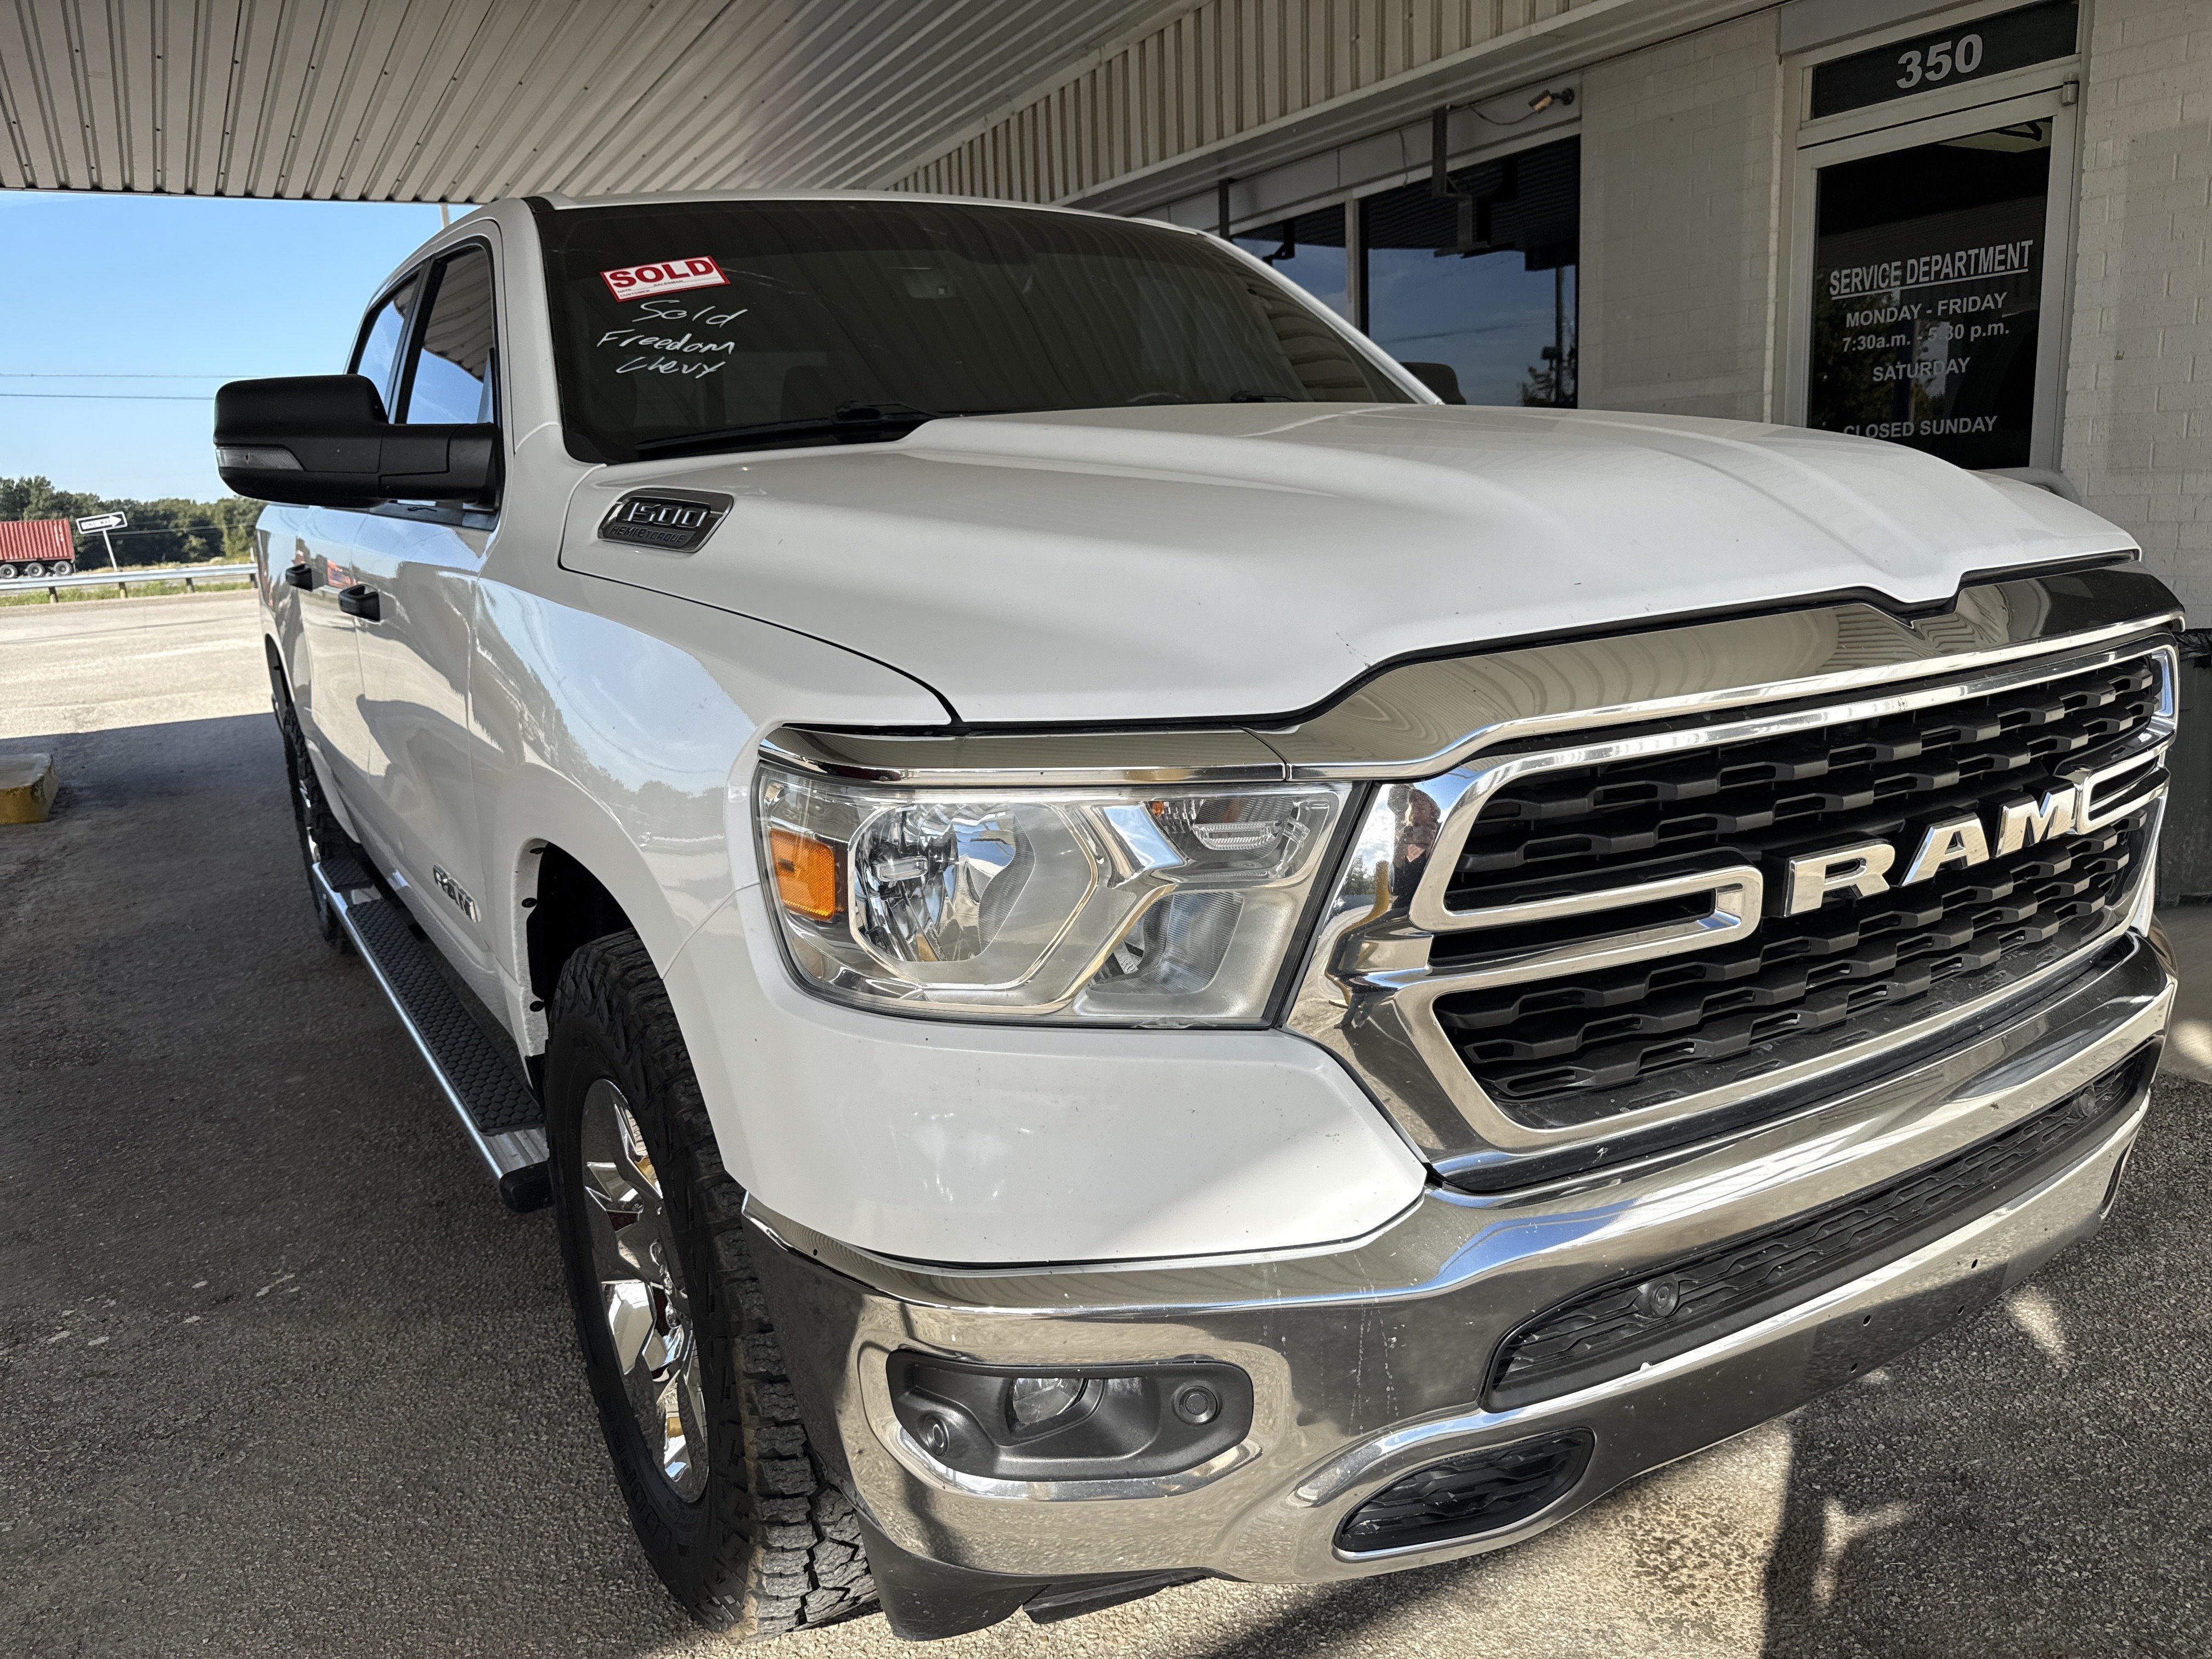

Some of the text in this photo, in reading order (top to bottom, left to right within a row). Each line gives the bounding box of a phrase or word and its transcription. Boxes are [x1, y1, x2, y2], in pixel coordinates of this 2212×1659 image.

[1896, 33, 1983, 89] 350
[609, 259, 714, 287] SOLD
[1830, 240, 2033, 296] SERVICE DEPARTMENT
[631, 300, 748, 328] Sold
[1846, 303, 1922, 328] MONDAY
[1937, 292, 2008, 316] FRIDAY
[596, 329, 735, 355] Freedom
[1842, 334, 1911, 352] 7:30a.m.
[1970, 322, 2010, 342] p.m.
[1872, 357, 1971, 382] SATURDAY
[1920, 415, 1997, 436] SUNDAY
[621, 500, 709, 529] 1500
[1782, 781, 2078, 918] RAM
